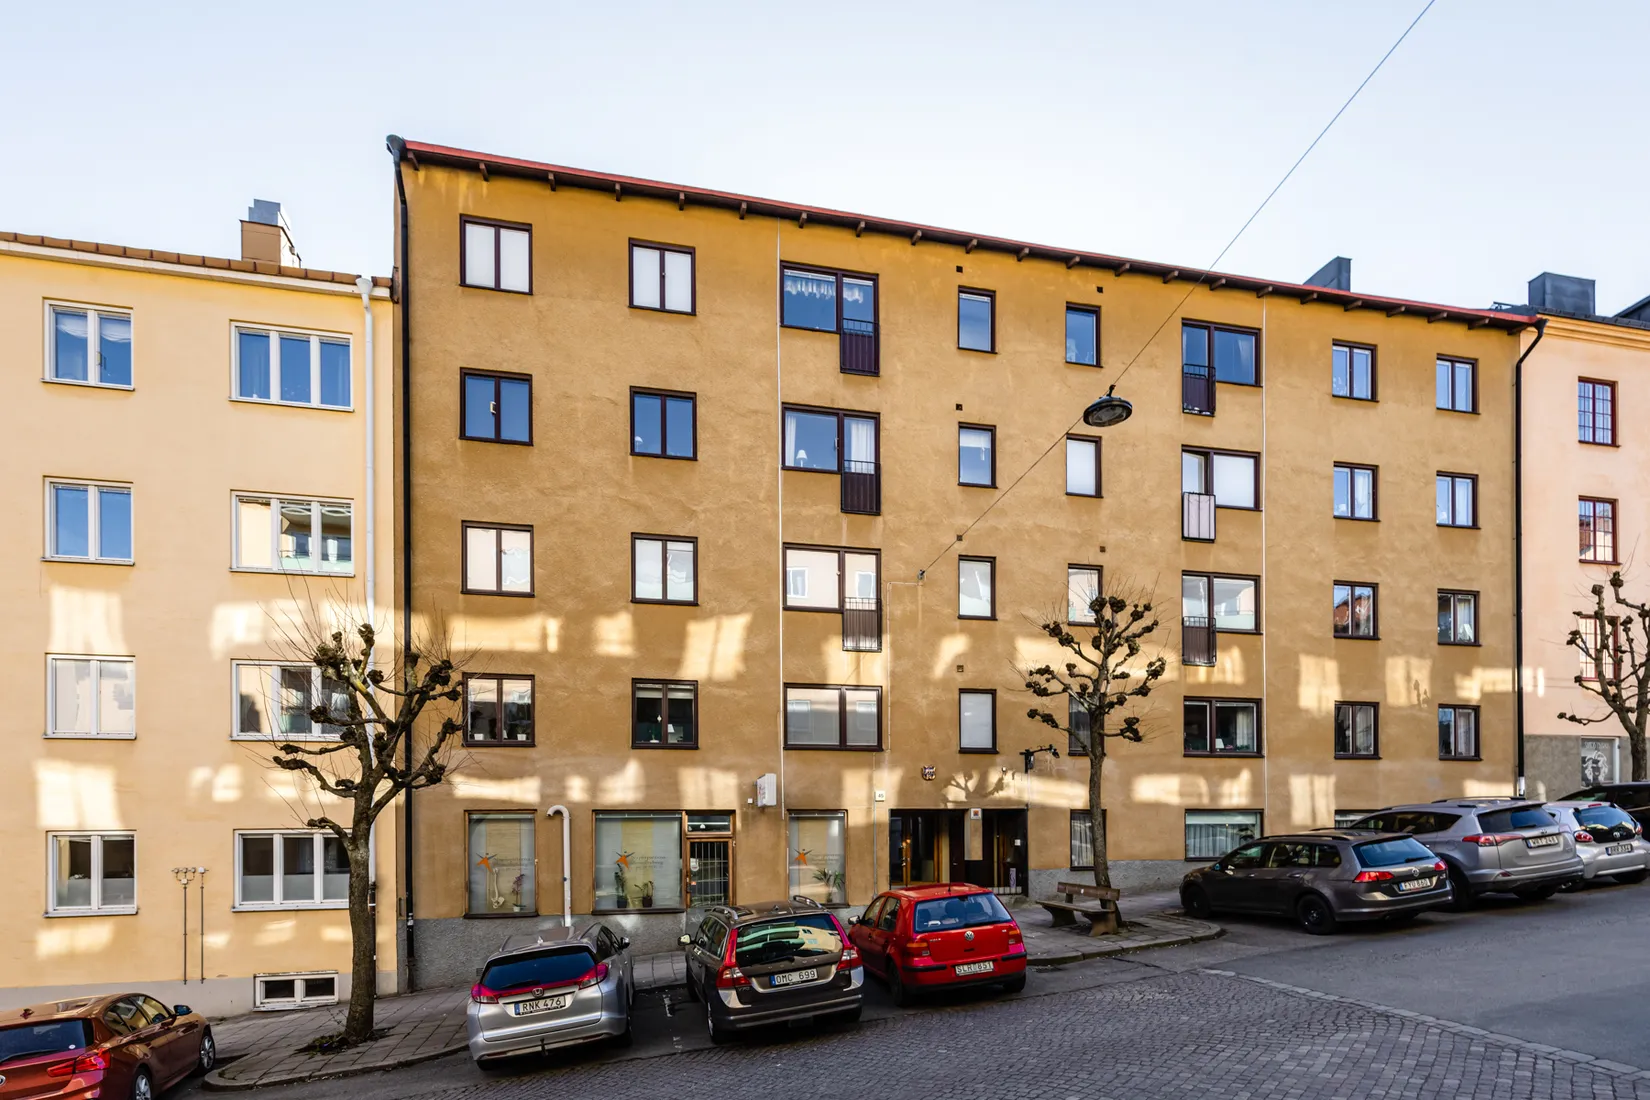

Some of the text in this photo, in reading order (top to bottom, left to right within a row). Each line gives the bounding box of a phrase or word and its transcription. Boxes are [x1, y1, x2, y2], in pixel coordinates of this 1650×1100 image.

[957, 965, 973, 973] SLR
[776, 970, 816, 984] OMC 699
[522, 998, 562, 1012] RNK 476
